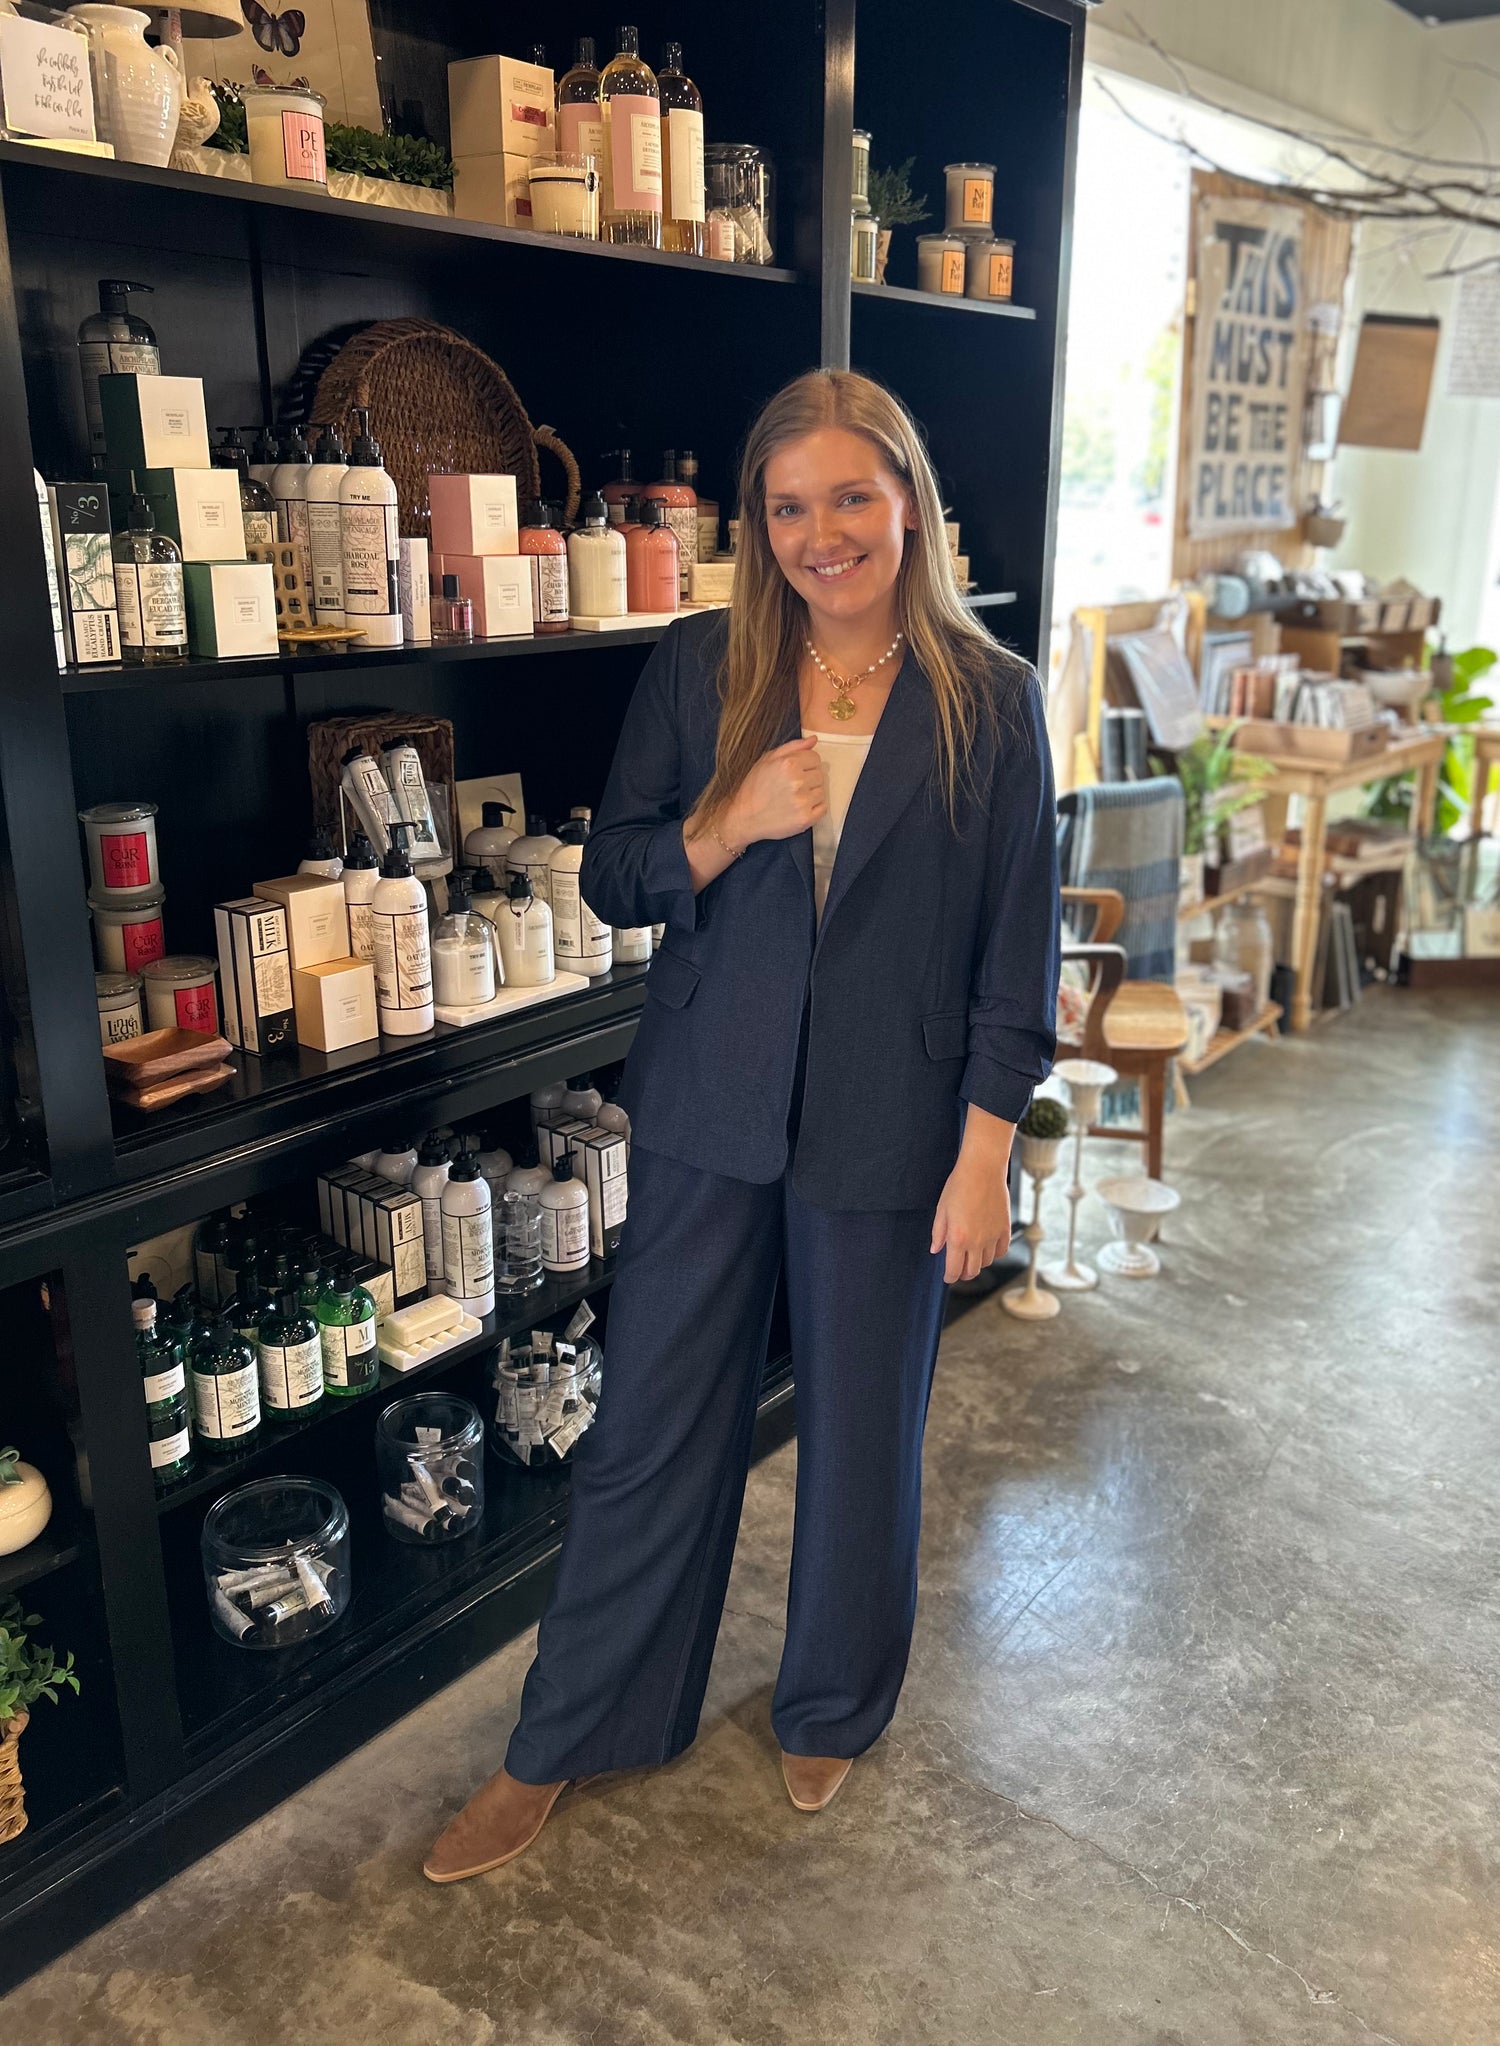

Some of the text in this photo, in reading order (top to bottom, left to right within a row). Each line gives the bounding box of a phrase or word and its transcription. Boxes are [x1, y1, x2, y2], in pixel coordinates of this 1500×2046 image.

[1214, 221, 1298, 322] THIS
[1208, 321, 1294, 391] MUST
[1204, 392, 1288, 454] BE THE
[1196, 463, 1286, 519] PLACE
[350, 561, 370, 569] ROSE
[264, 915, 277, 949] MILK
[358, 1326, 370, 1342] M
